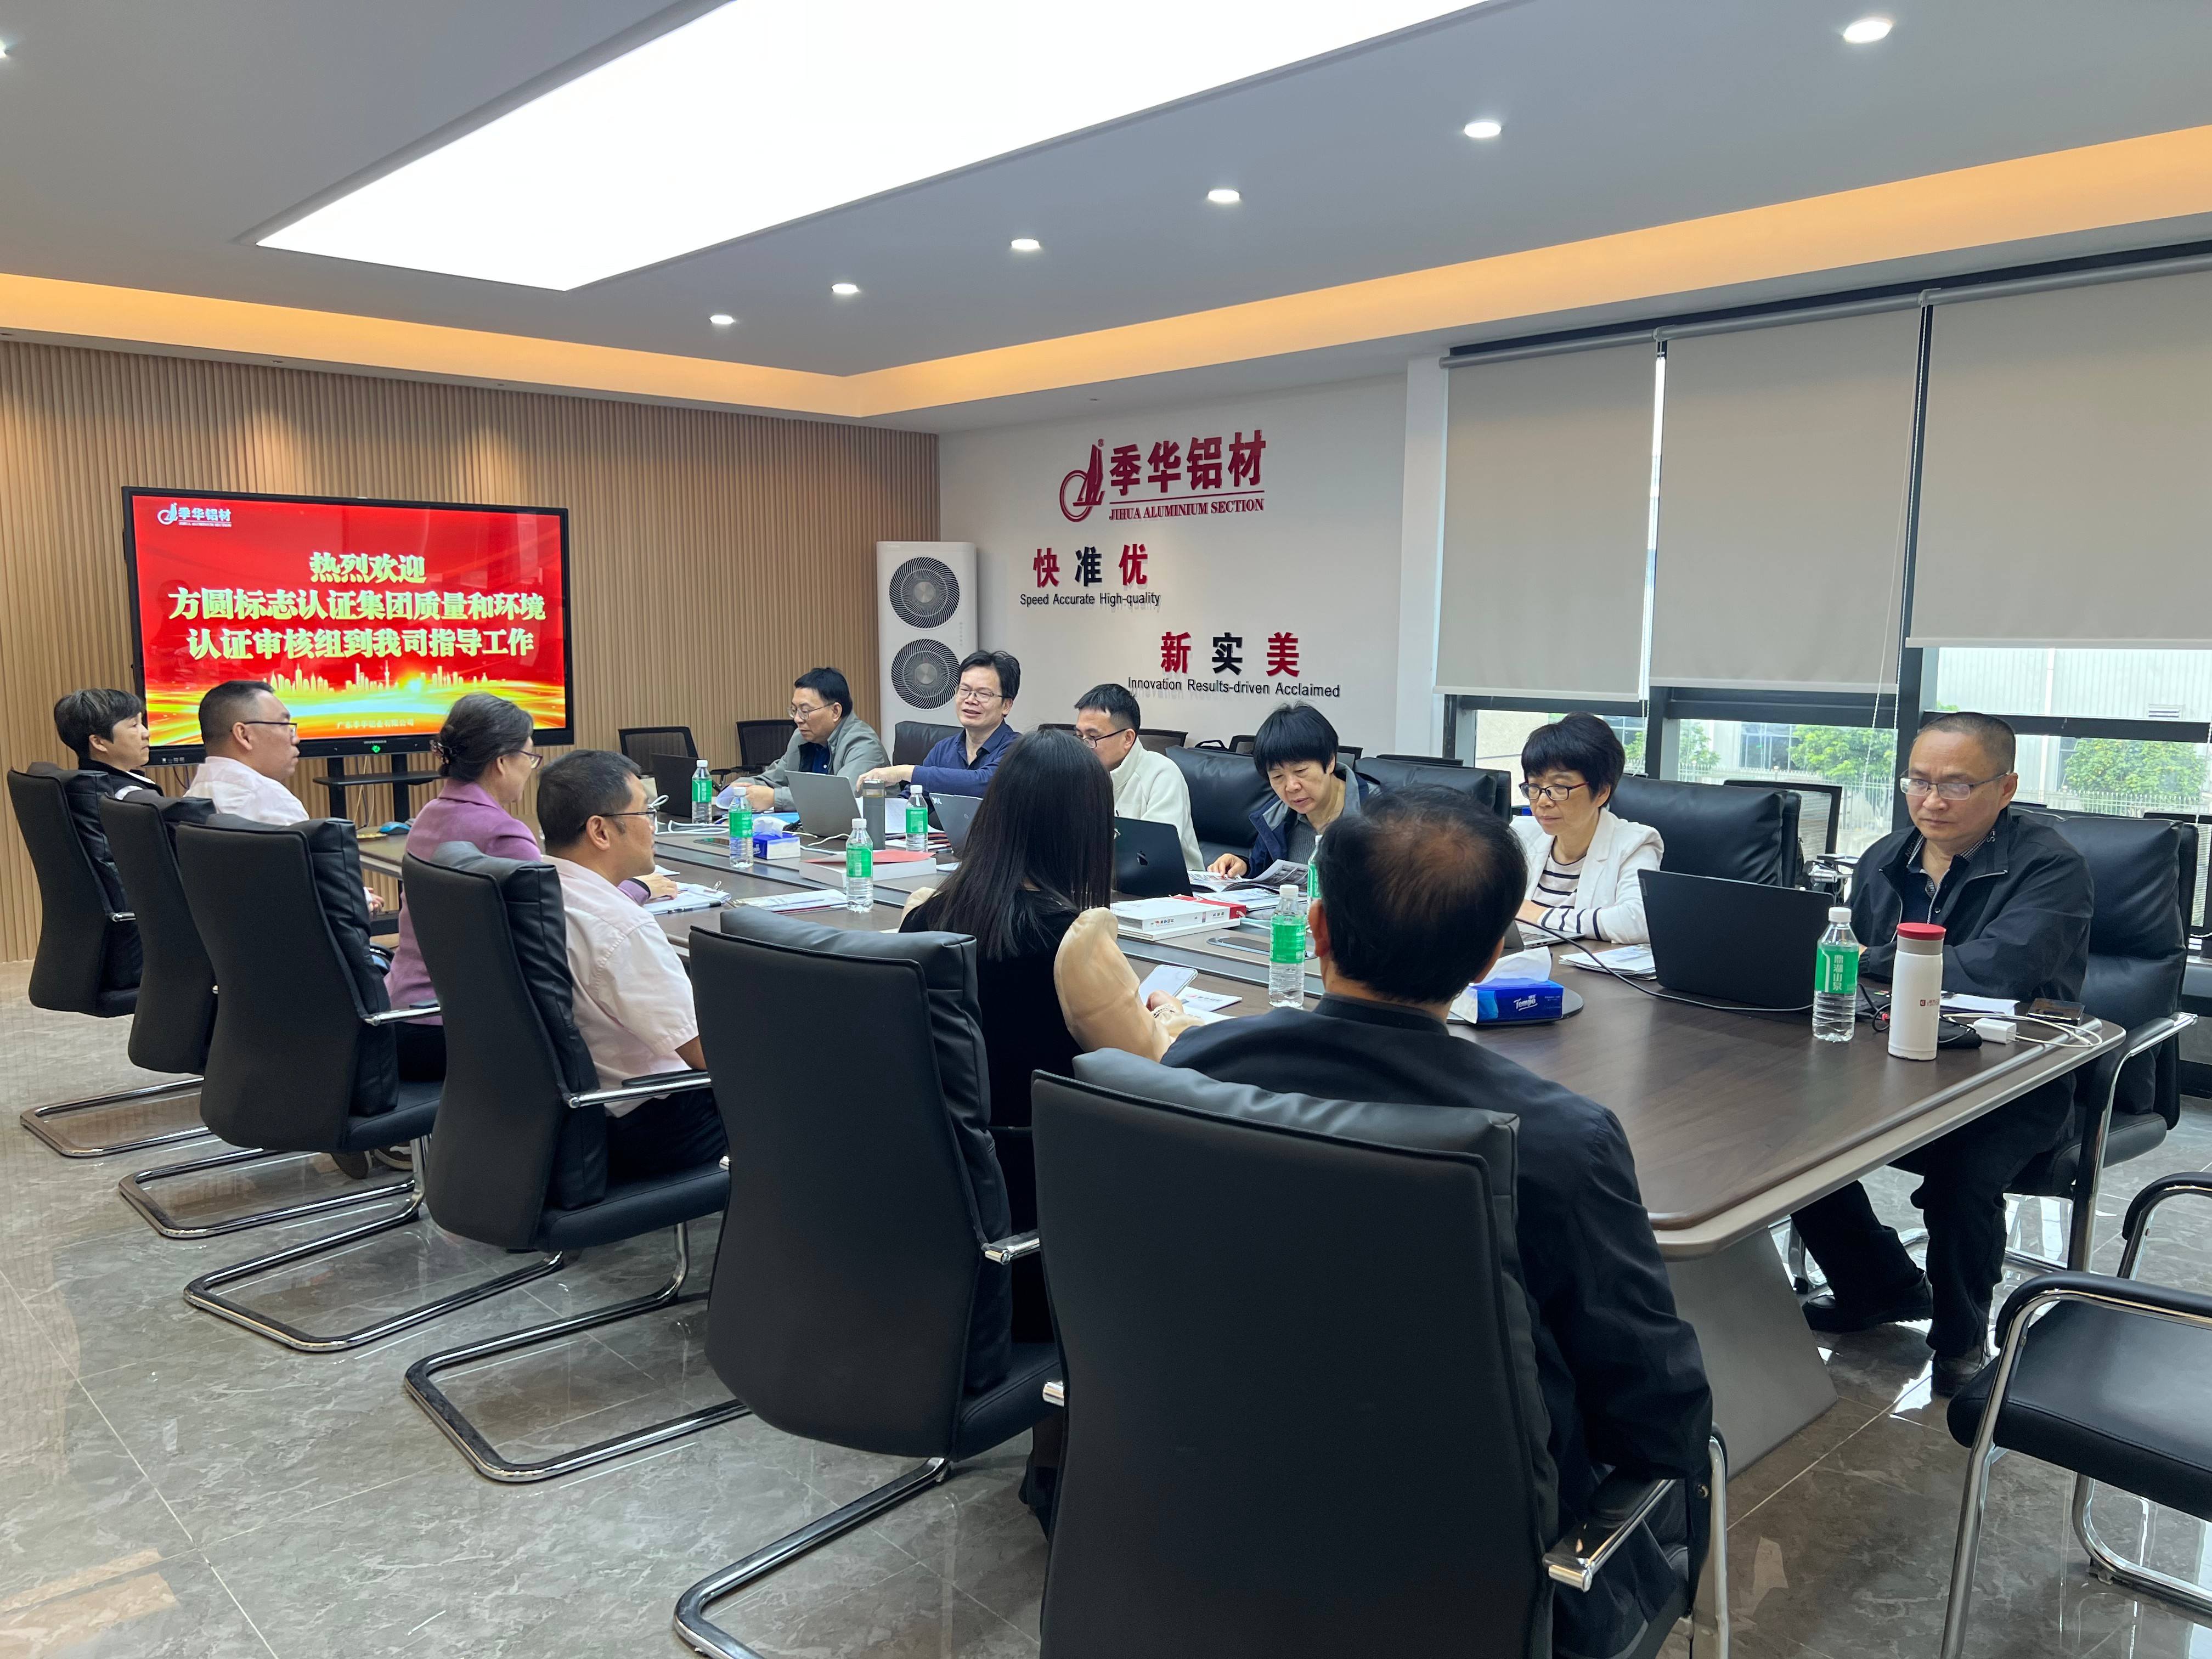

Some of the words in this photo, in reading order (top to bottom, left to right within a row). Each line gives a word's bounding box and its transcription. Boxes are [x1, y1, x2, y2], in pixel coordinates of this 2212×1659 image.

[1109, 430, 1266, 496] 季华铝材
[1109, 507, 1142, 521] JIHUA
[1143, 502, 1209, 519] ALUMINIUM
[1210, 498, 1265, 514] SECTION
[309, 551, 427, 584] 热烈欢迎
[168, 587, 546, 620] 方圆标志认证集团质量和环境
[1020, 594, 1049, 607] Speed
[1052, 593, 1096, 605] Accurate
[1099, 591, 1161, 607] High-quality
[185, 628, 535, 661] 认证审核组到我司指导工作
[1128, 676, 1182, 691] Innovation
[1187, 678, 1269, 695] Results-driven
[1274, 682, 1341, 697] Acclaimed
[1832, 955, 1844, 991] 鼎湖山泉
[1513, 997, 1537, 1010] Tempo
